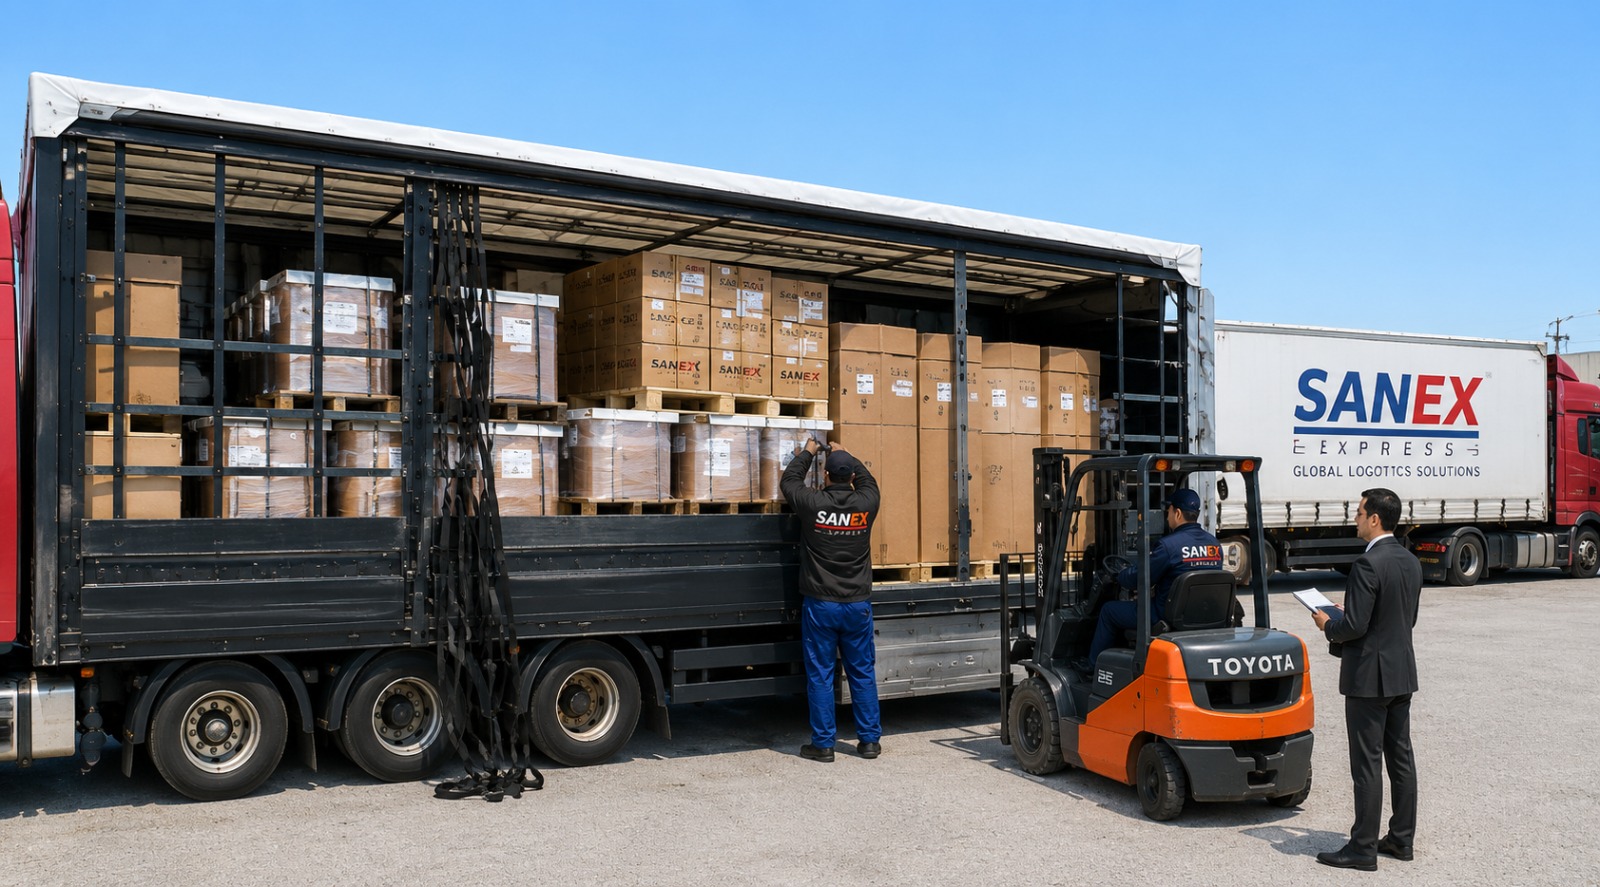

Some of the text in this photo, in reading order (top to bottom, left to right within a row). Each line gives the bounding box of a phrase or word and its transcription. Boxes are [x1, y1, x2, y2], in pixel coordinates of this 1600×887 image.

[780, 370, 821, 382] SANEX
[1294, 368, 1484, 426] SANEX
[1320, 440, 1454, 456] EXPRESS
[1293, 465, 1343, 478] GLOBAL
[1417, 465, 1481, 478] SOLUTIONS
[815, 510, 869, 527] SANEX
[1181, 545, 1221, 559] SANEX
[1207, 654, 1295, 676] TOYOTA
